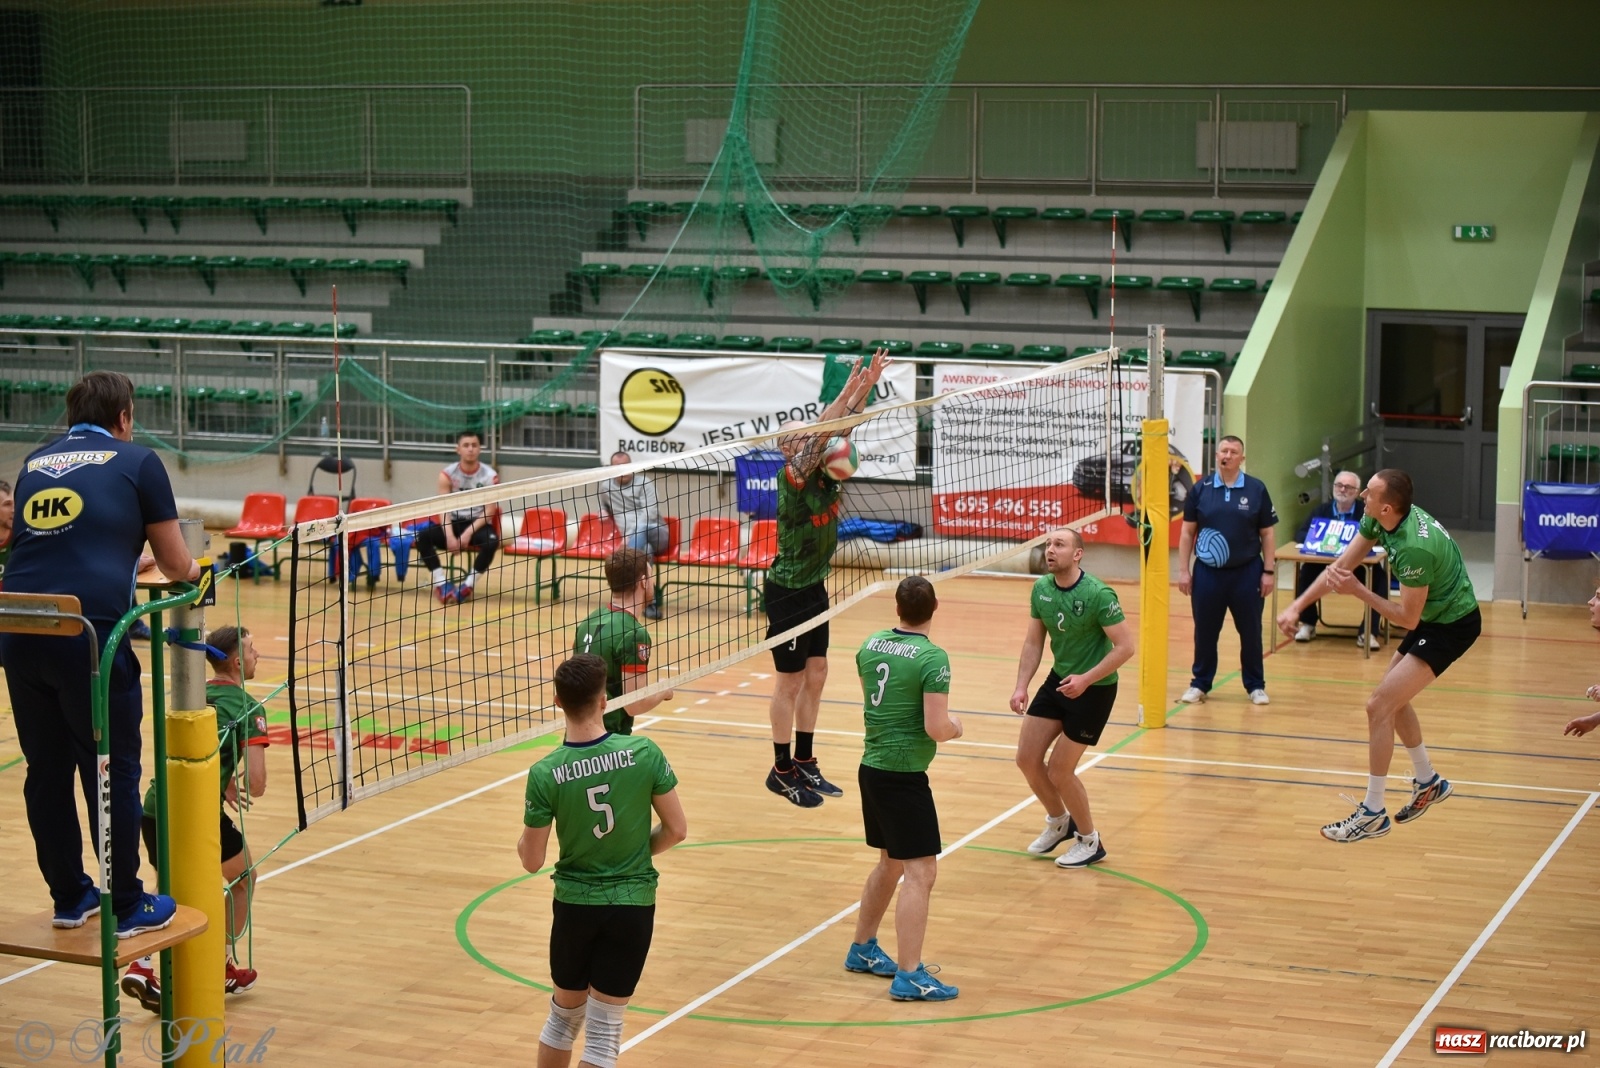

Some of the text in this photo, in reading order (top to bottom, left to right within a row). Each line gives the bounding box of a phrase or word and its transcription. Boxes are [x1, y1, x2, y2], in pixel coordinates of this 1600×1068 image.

[751, 415, 770, 434] W
[618, 438, 686, 454] RACIBÓRZ
[31, 496, 73, 520] HK
[955, 495, 1063, 518] 695 496 555
[1083, 523, 1098, 534] 45
[1315, 521, 1327, 539] 7
[1538, 512, 1598, 528] molten
[1341, 524, 1356, 541] 10
[1057, 611, 1065, 632] 2
[866, 637, 921, 659] WŁODOWICE
[870, 662, 890, 707] 3
[552, 749, 636, 785] WŁODOWICE
[586, 783, 616, 840] 5
